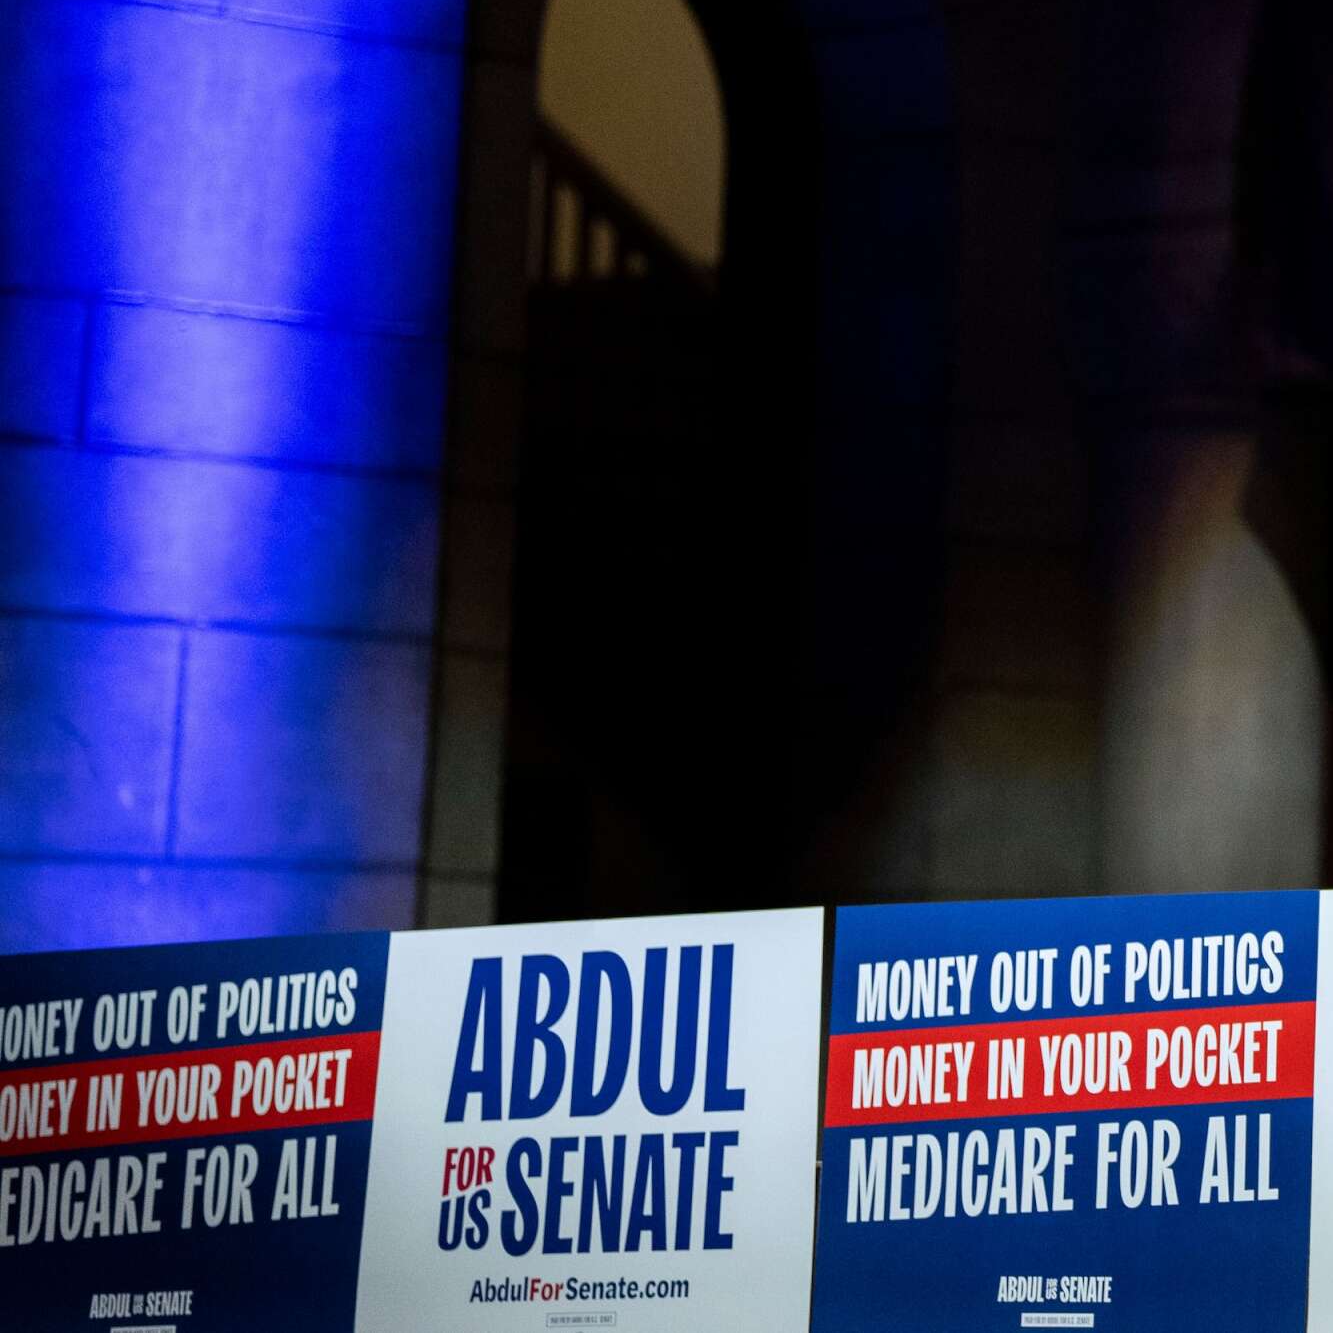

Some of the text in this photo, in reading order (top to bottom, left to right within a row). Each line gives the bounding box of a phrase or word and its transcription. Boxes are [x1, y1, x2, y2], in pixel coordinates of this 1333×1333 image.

[0, 967, 358, 1062] ONEY OUT OF POLITICS
[855, 930, 1284, 1024] MONEY OUT OF POLITICS
[444, 943, 746, 1123] ABDUL
[852, 1019, 1282, 1110] MONEY IN YOUR POCKET
[86, 1073, 124, 1131] IN
[136, 1060, 219, 1127] YOUR
[230, 1049, 352, 1121] POCKET
[181, 1143, 259, 1232] FOR
[272, 1135, 340, 1219] ALL
[437, 1131, 739, 1257] US SENATE
[442, 1147, 495, 1196] FOR
[846, 1112, 1279, 1224] MEDICARE FOR ALL
[89, 1293, 131, 1318] ABDUL
[146, 1290, 193, 1316] SENATE
[470, 1276, 689, 1303] AbdulForSenate.com
[997, 1276, 1112, 1303] ABDUL SENATE
